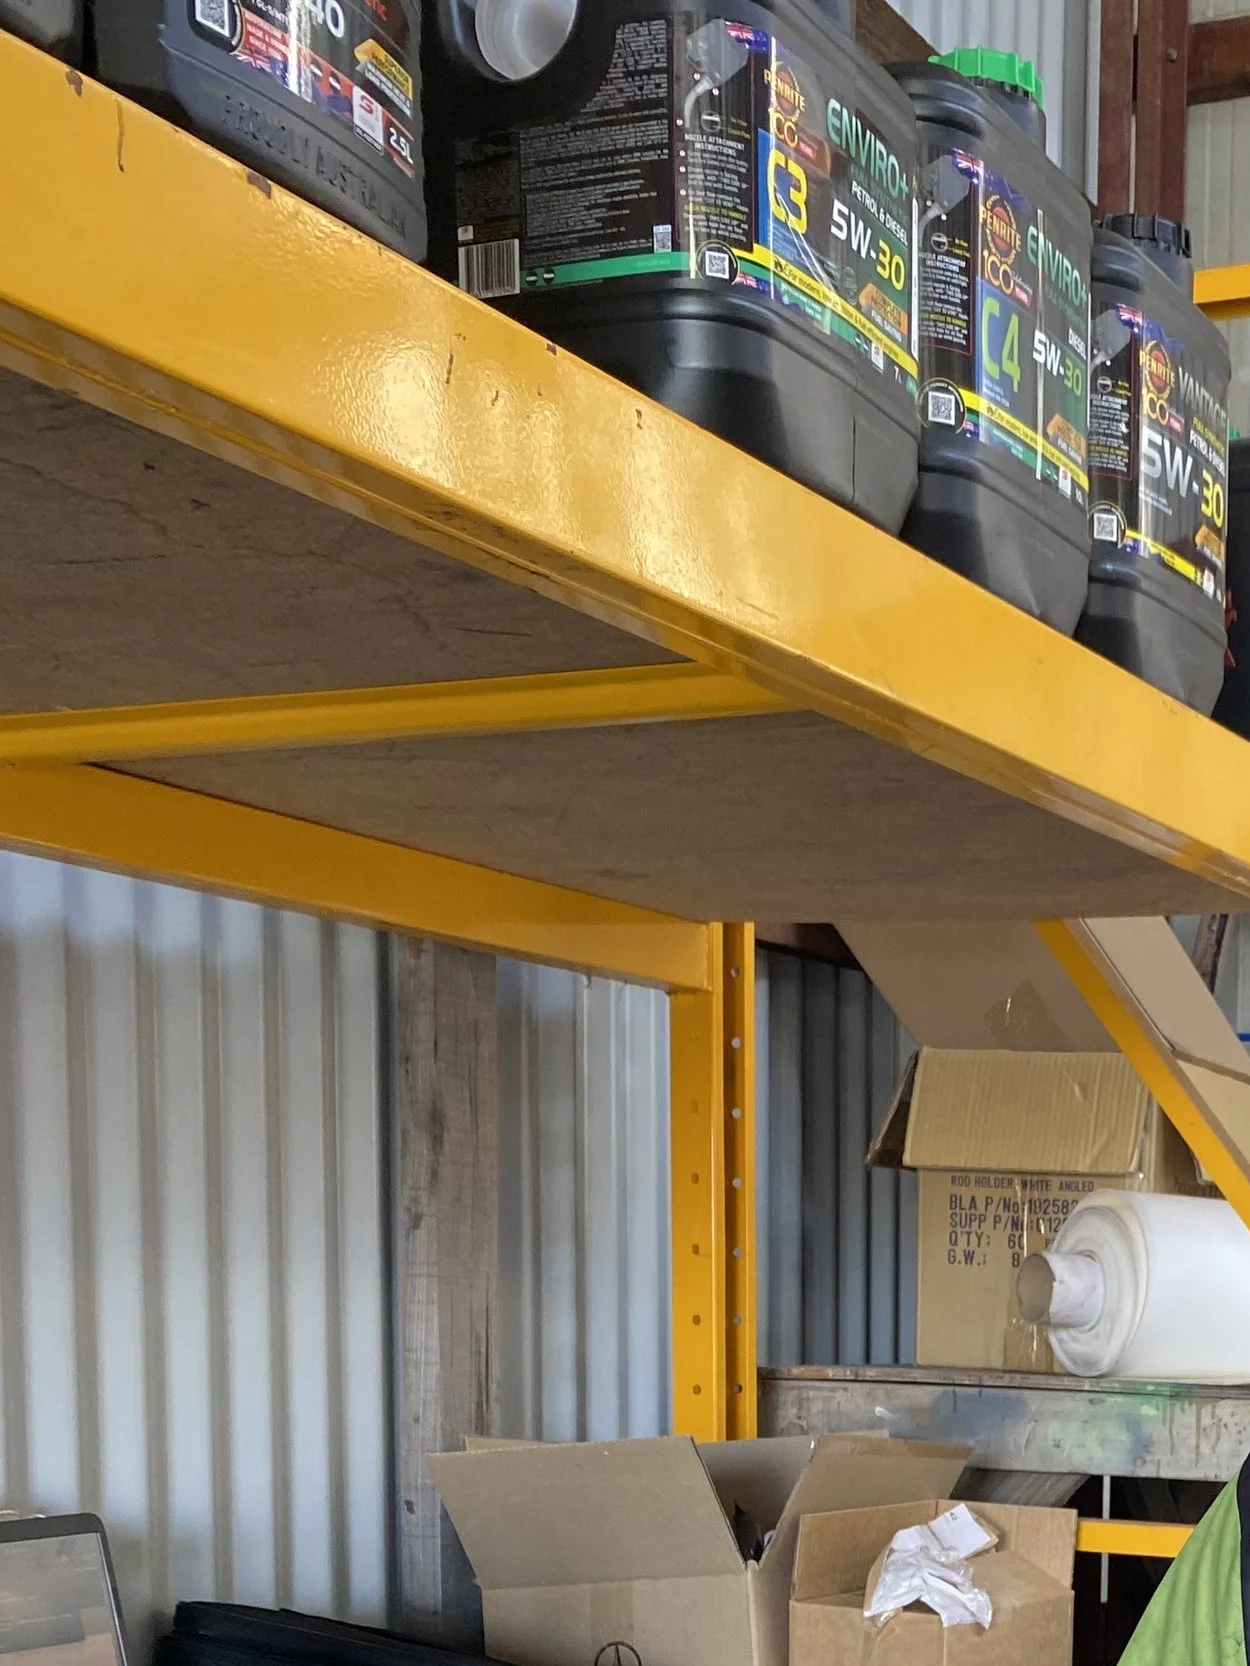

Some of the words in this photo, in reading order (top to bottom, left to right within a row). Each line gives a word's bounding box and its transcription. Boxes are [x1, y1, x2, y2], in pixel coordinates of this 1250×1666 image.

[763, 68, 806, 113] PENRITE
[826, 98, 910, 201] ENVIRO+
[767, 148, 808, 235] C3
[852, 180, 879, 218] PETROL
[886, 212, 908, 246] DIESEL
[830, 198, 905, 291] 5W-30
[979, 204, 1022, 253] PENRITE
[1027, 225, 1087, 309] ENVIRO+
[981, 296, 1021, 393] C4
[1032, 329, 1082, 397] 5W-30
[1068, 327, 1087, 361] DIESEL
[1139, 349, 1176, 389] PENRITE
[1142, 426, 1224, 529] 5W-30
[949, 1193, 978, 1212] BLA
[950, 1175, 970, 1187] ROD
[974, 1176, 1014, 1189] HOLDER
[1021, 1179, 1051, 1191] WHITE
[1058, 1180, 1095, 1193] ANGLED
[950, 1213, 986, 1230] SUPP
